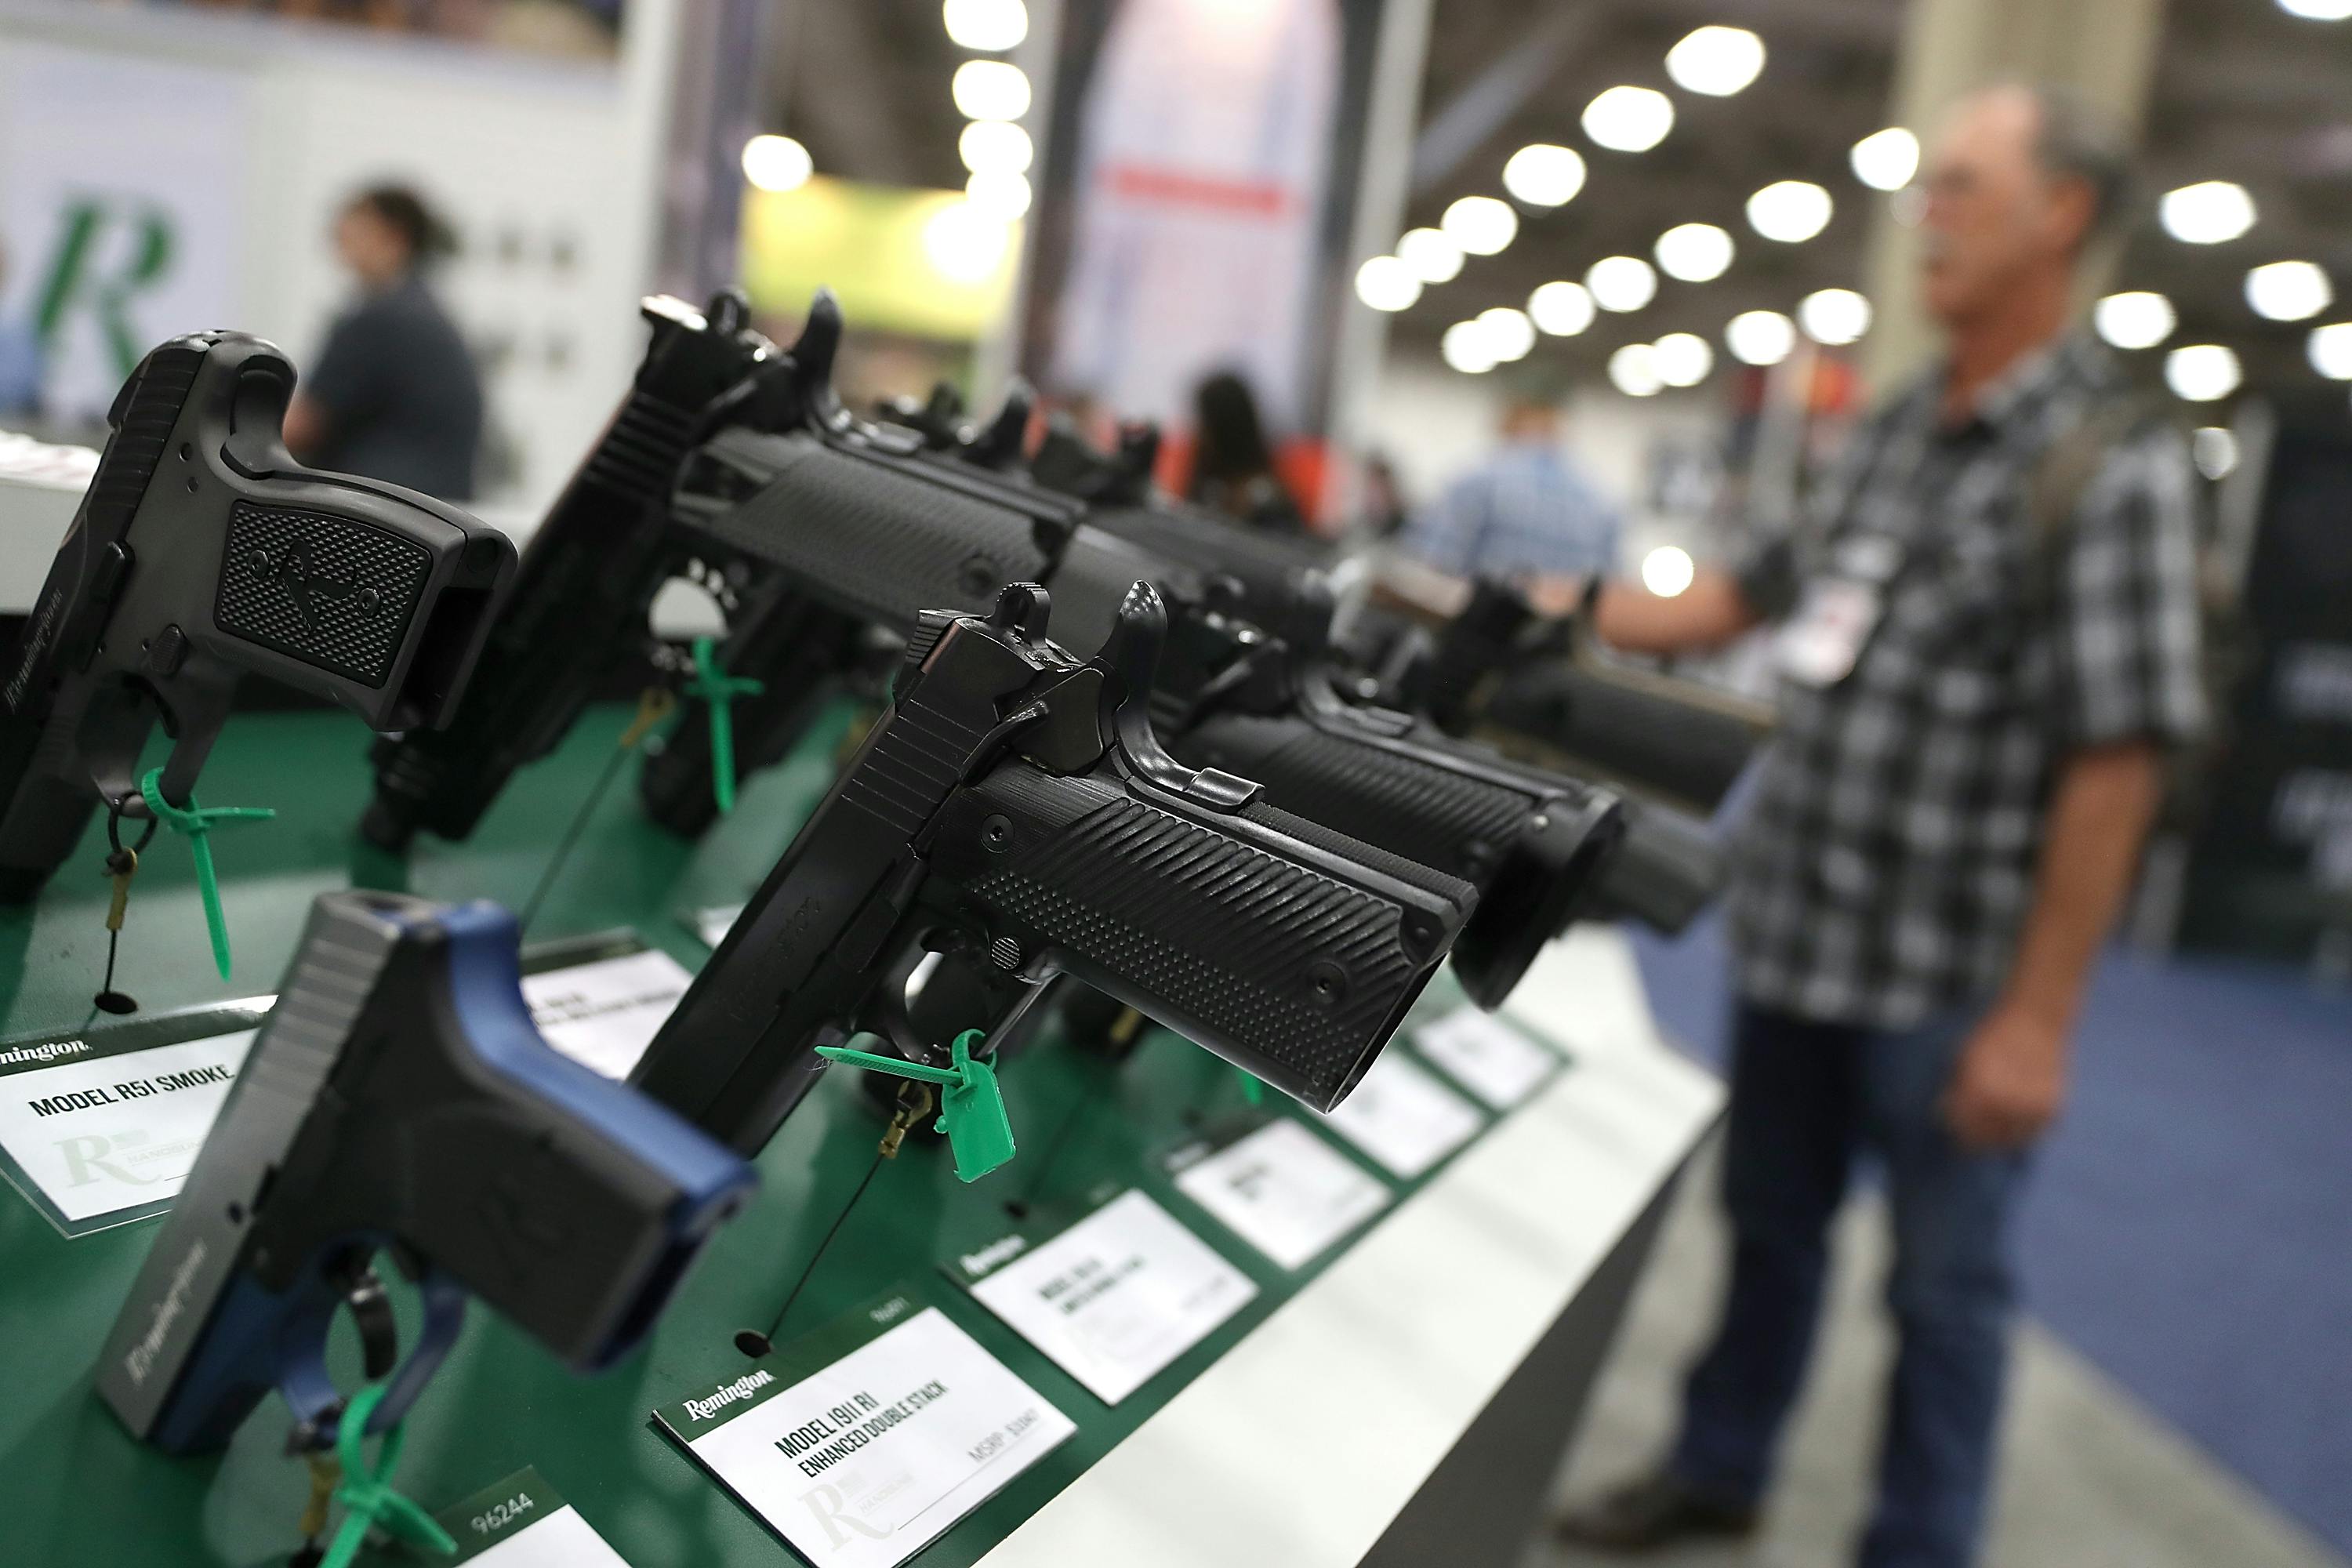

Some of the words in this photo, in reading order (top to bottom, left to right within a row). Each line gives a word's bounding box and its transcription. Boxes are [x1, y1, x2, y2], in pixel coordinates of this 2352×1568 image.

[0, 1040, 89, 1065] mington
[28, 1088, 119, 1117] MODEL
[155, 1064, 235, 1091] SMOKE
[682, 1370, 775, 1421] Remington
[774, 1417, 837, 1459] MODEL
[826, 1401, 863, 1428] 1911
[852, 1390, 880, 1412] R1
[797, 1428, 870, 1478] ENHANCED
[862, 1401, 913, 1438] DOUBLE
[905, 1378, 949, 1410] STACK
[470, 1492, 534, 1534] 96244
